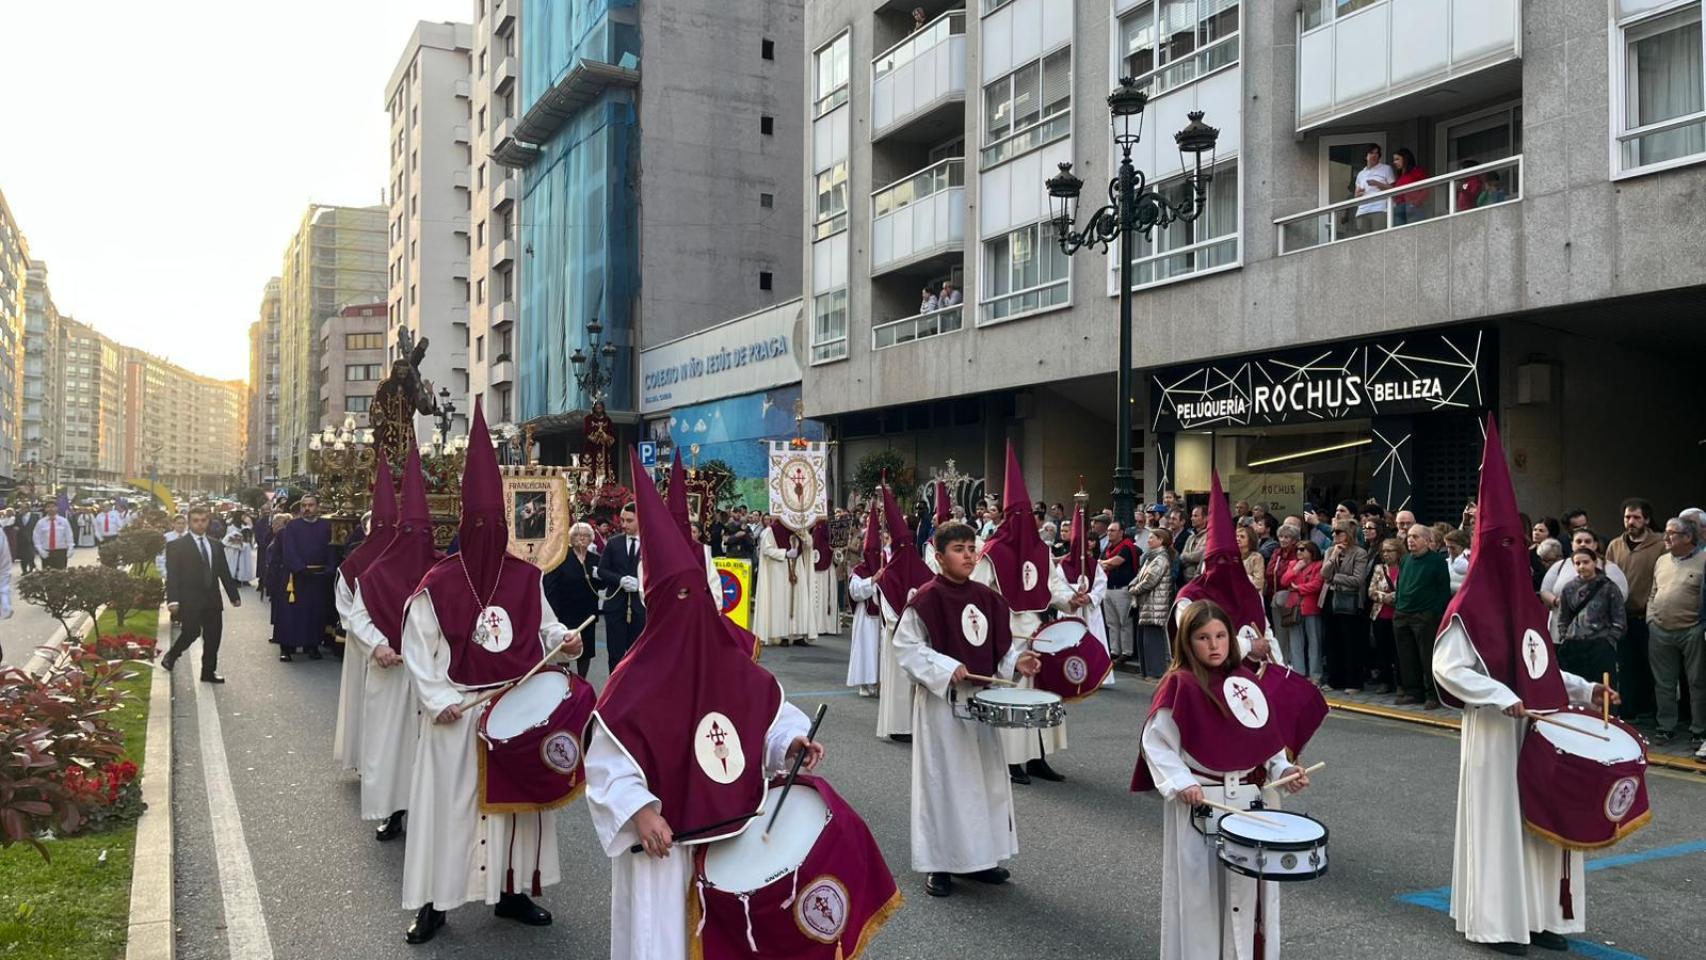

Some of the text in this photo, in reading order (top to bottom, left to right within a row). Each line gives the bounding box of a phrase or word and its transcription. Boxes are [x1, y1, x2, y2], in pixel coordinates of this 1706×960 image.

[645, 334, 788, 391] COLEGIO NIÑO JESÚS DE PRAGA
[1177, 376, 1442, 419] PELUQUERÍA ROCHUS BELLEZA
[642, 444, 652, 463] P
[508, 482, 552, 490] FRANCISCANA
[1261, 485, 1296, 495] ROCHUS
